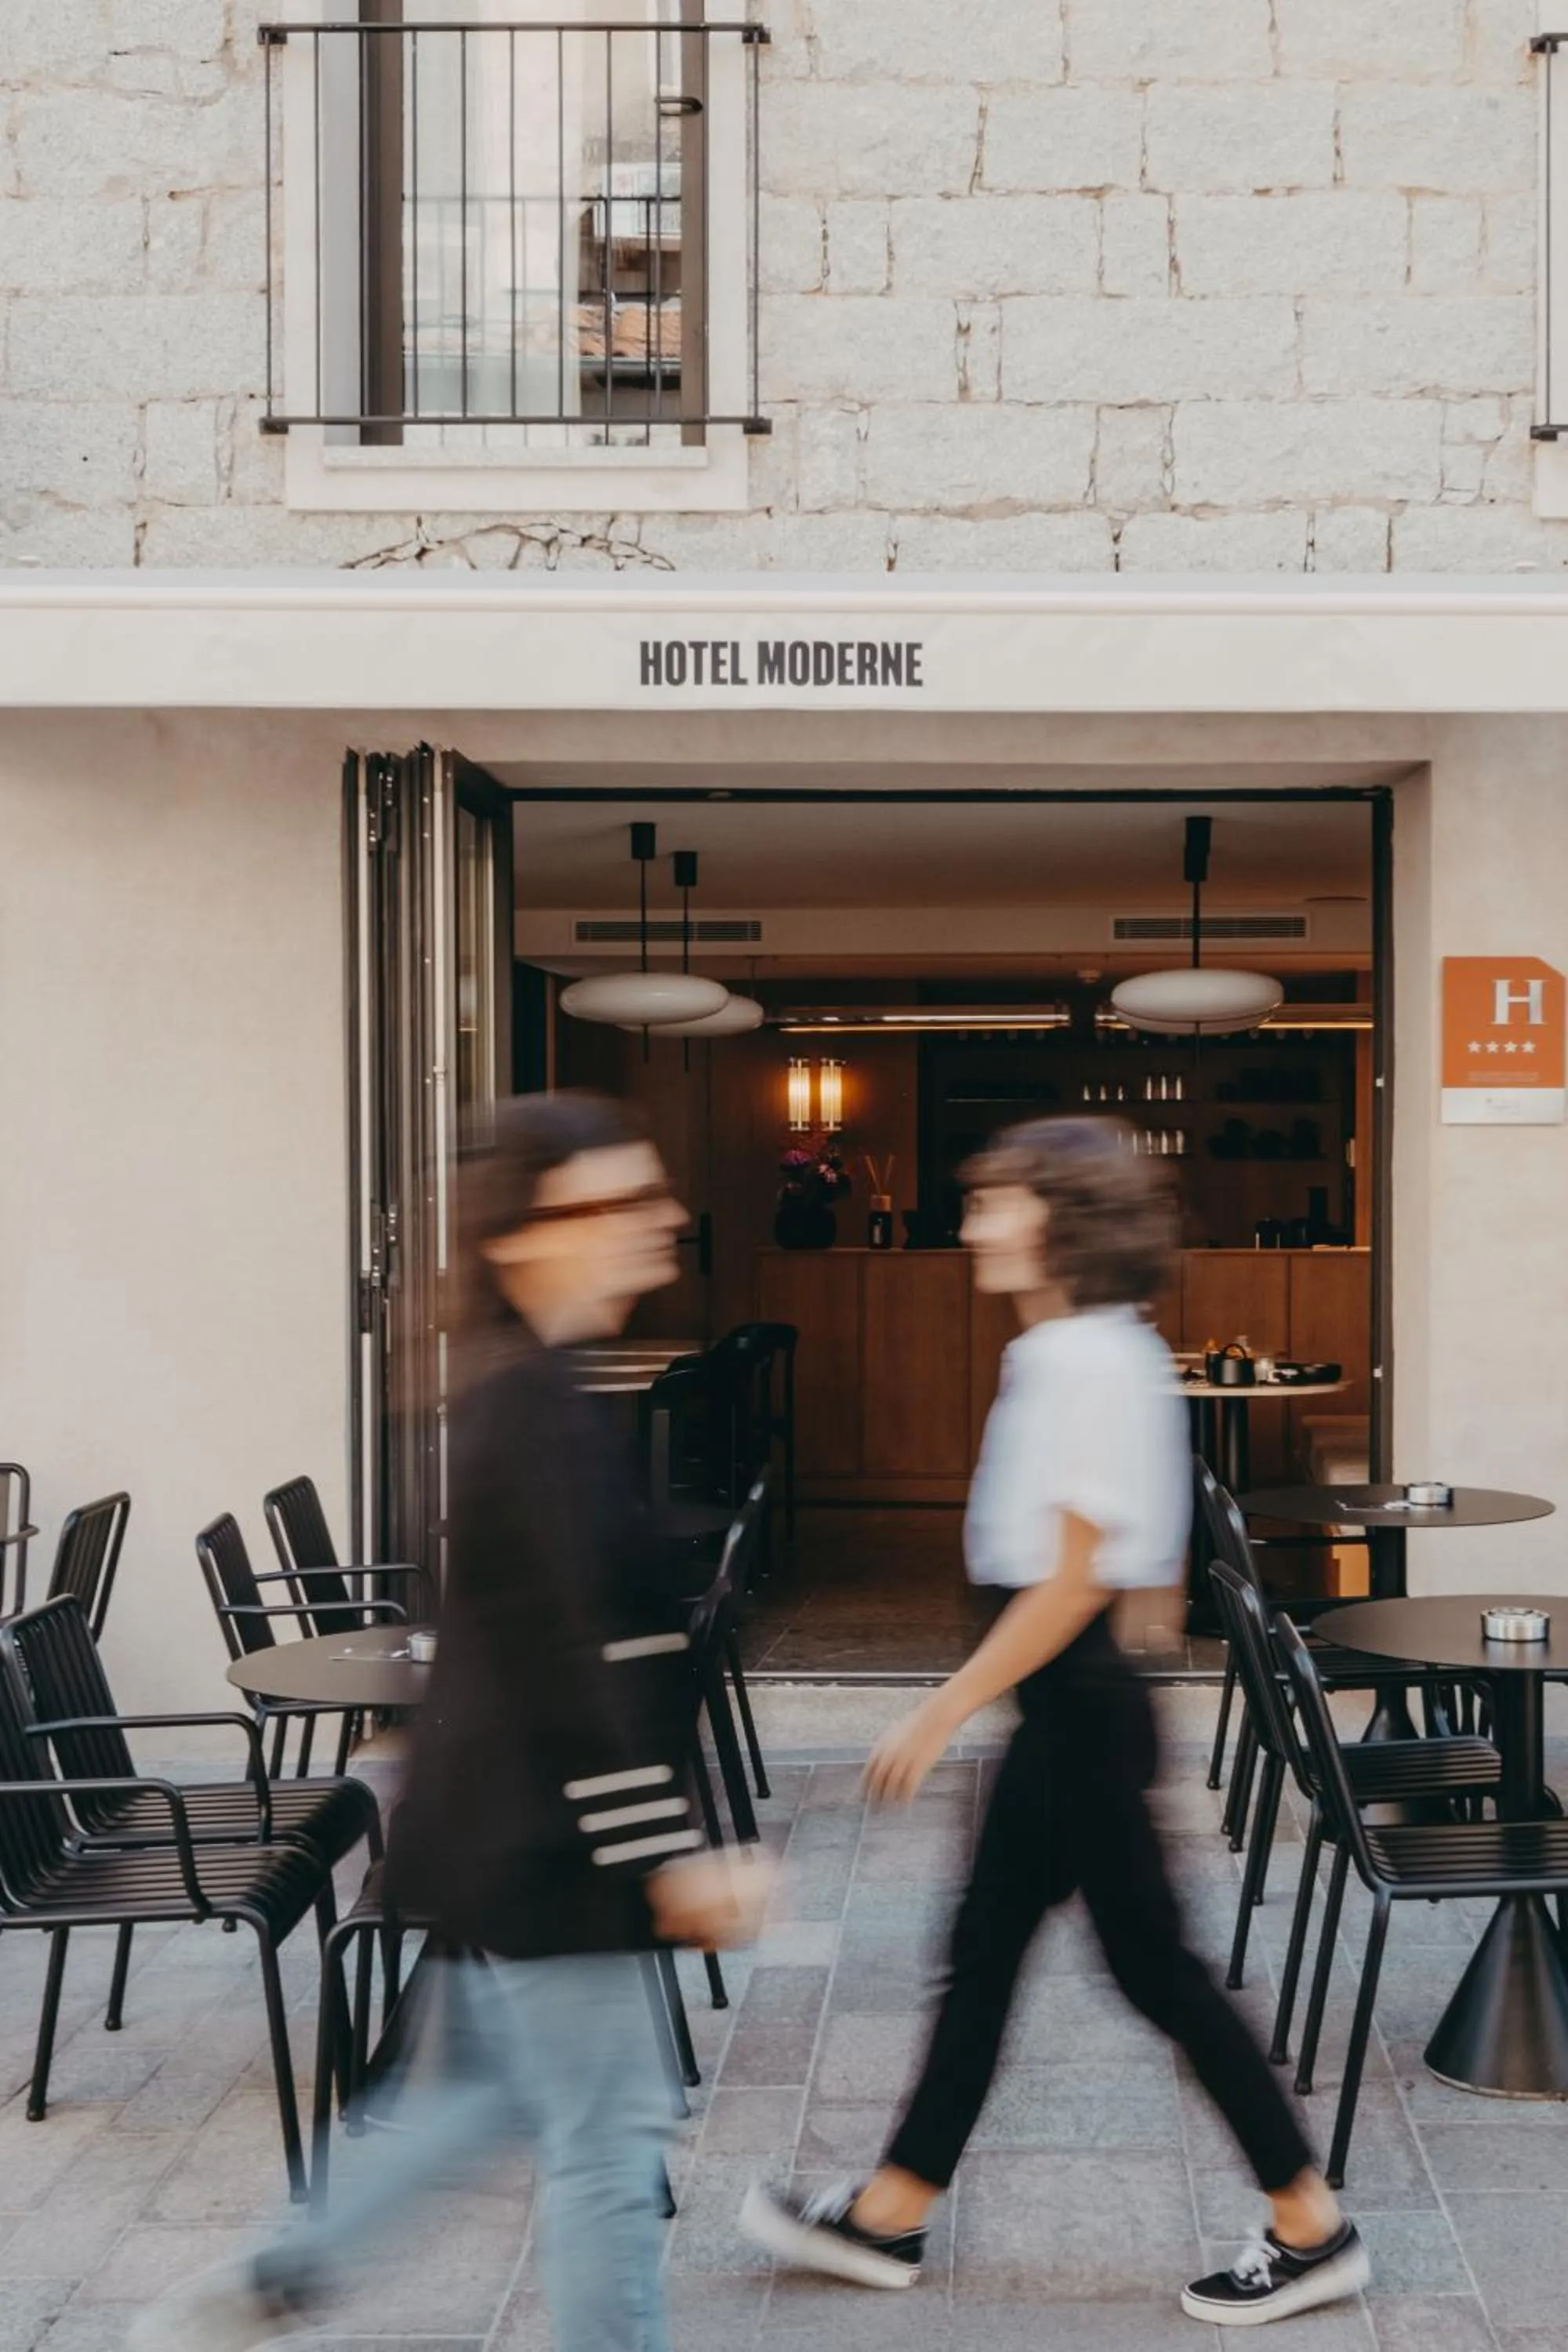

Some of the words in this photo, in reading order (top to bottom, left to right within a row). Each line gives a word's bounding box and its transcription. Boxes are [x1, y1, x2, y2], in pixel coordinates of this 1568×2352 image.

[640, 641, 748, 686] HOTEL
[757, 640, 923, 686] MODERNE
[1491, 979, 1547, 1025] H
